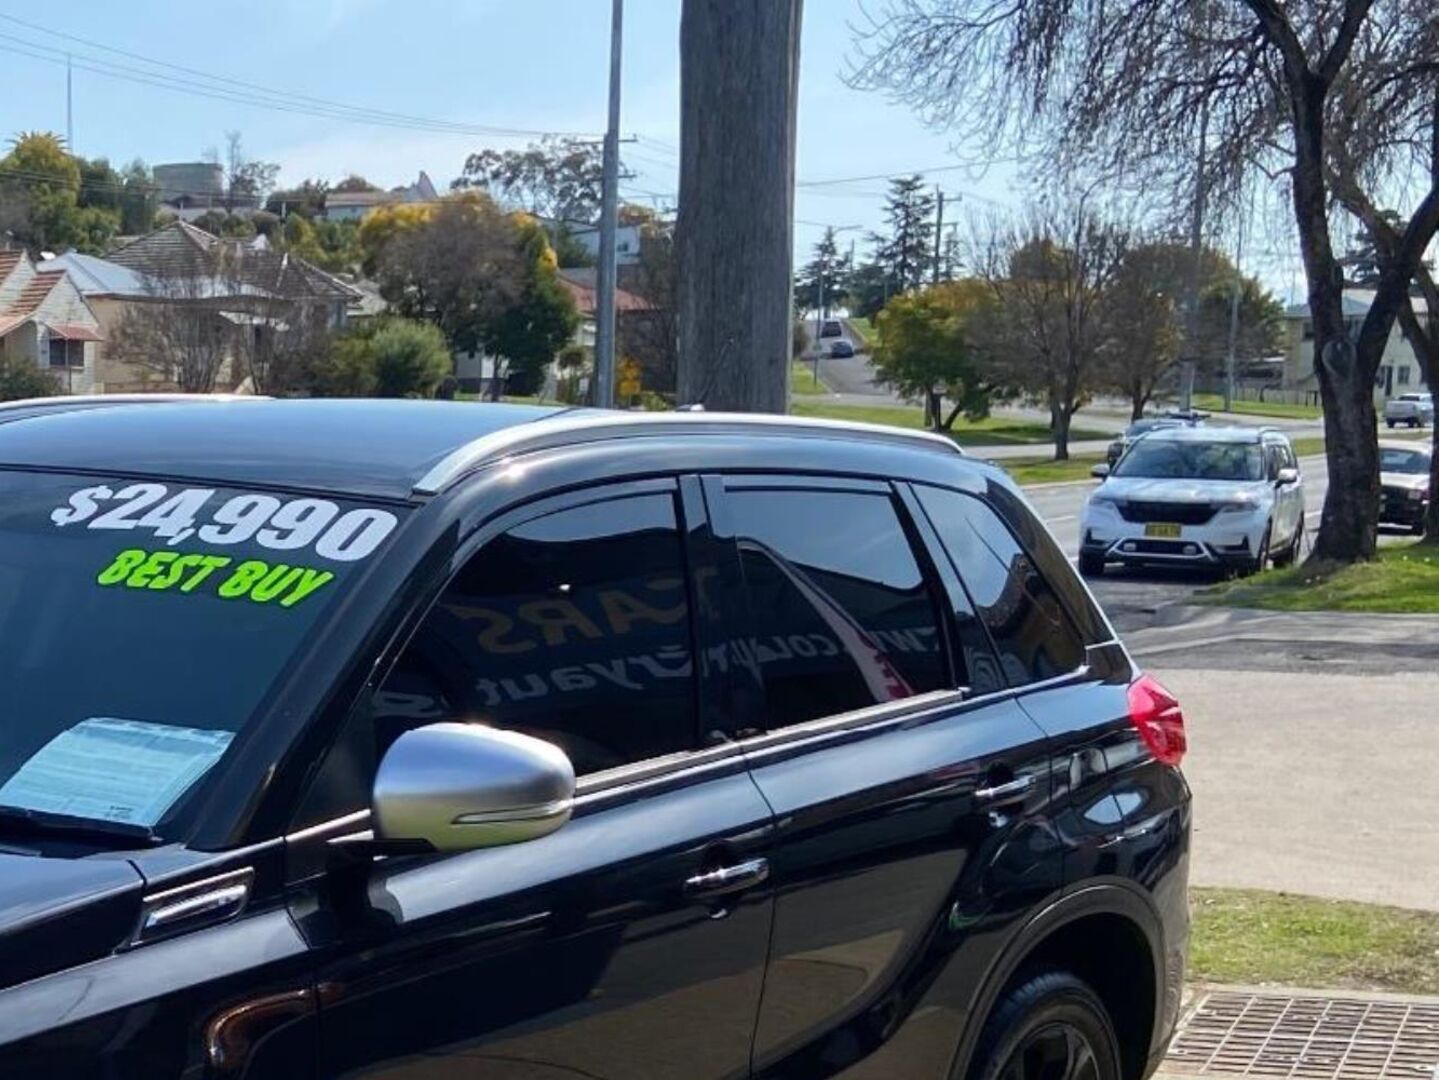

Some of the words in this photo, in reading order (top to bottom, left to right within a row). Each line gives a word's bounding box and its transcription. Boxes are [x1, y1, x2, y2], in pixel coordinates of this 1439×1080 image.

[50, 483, 398, 563] $24,990
[98, 549, 231, 593] BEST
[218, 560, 335, 608] BUY
